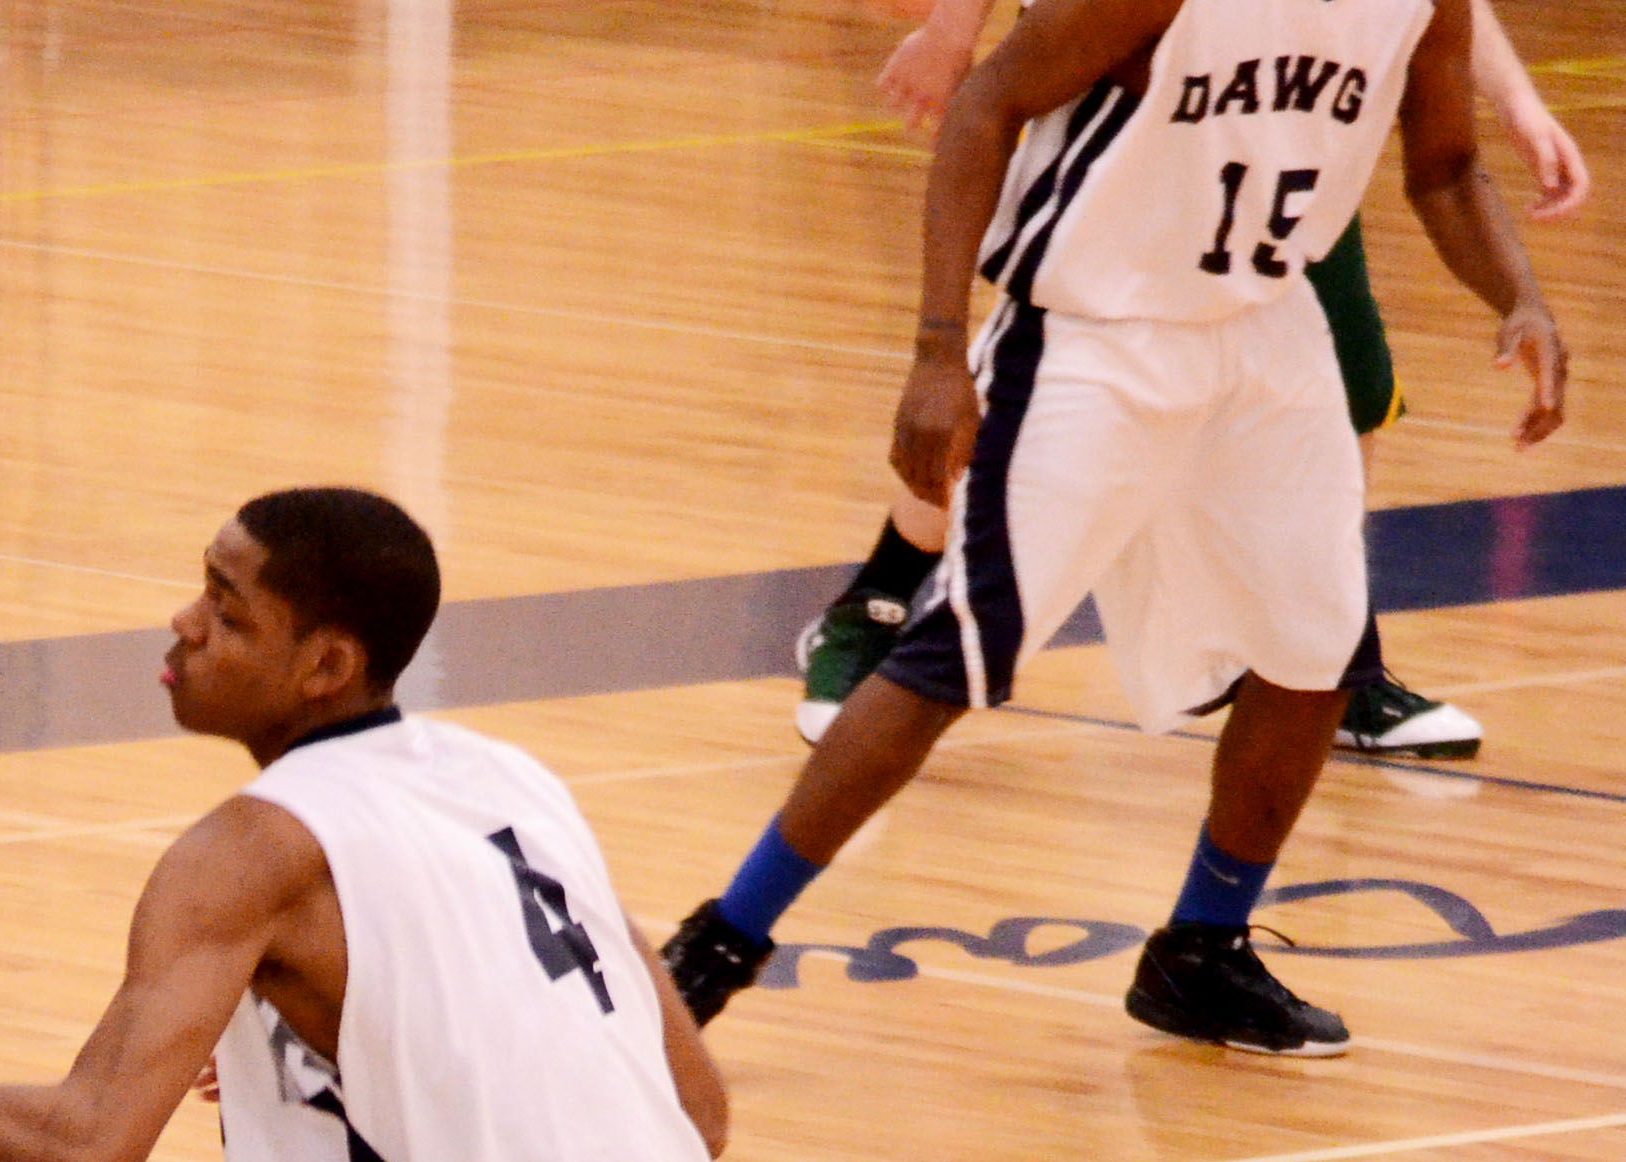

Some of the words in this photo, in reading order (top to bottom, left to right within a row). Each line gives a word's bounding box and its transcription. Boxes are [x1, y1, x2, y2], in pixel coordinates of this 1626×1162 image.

[1170, 54, 1368, 125] DAWG
[1197, 160, 1321, 278] 15
[486, 826, 617, 1015] 4
